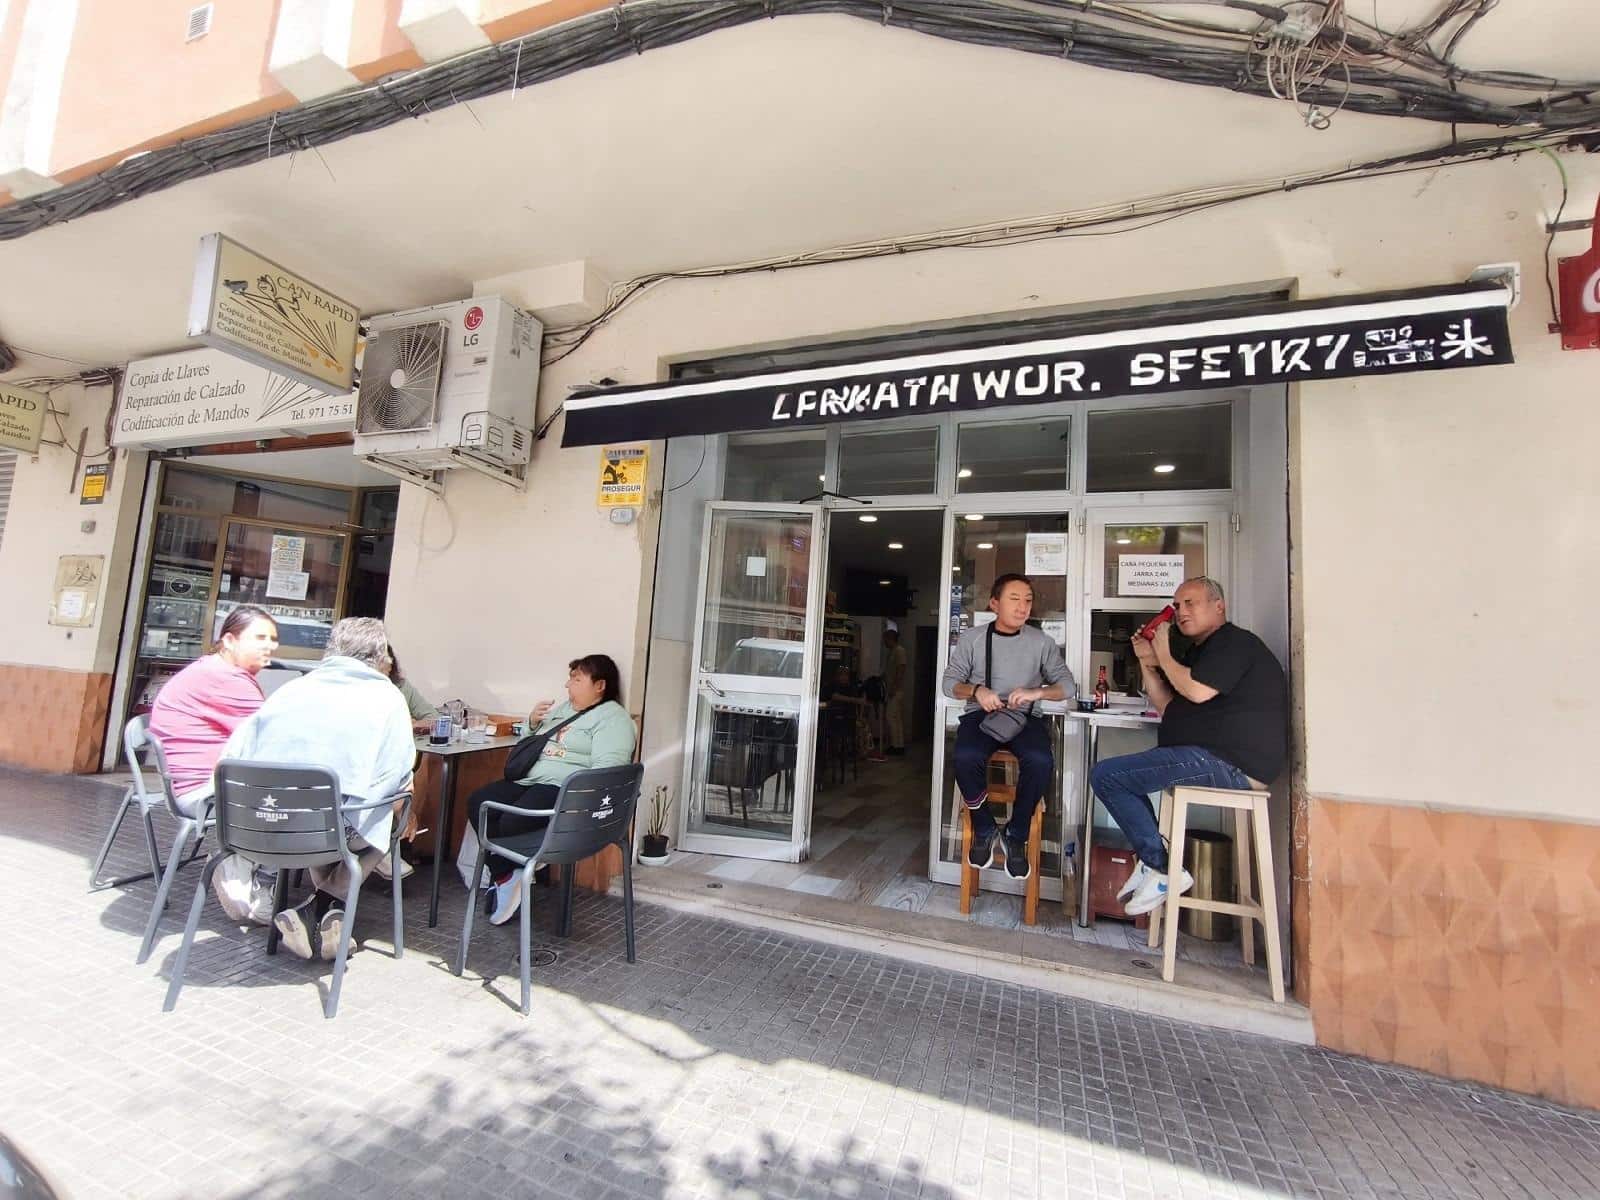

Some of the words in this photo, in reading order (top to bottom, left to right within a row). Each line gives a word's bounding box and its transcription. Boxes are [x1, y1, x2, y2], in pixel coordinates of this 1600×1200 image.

[219, 302, 245, 319] Copia
[246, 315, 257, 326] de
[258, 319, 283, 336] Llaves
[314, 294, 354, 324] RAPID
[216, 321, 270, 350] Codificación
[271, 344, 281, 355] de
[282, 348, 312, 368] Mandos
[218, 311, 264, 339] Reparación
[265, 332, 276, 342] de
[277, 338, 308, 357] Calzado
[463, 333, 479, 347] LG
[129, 371, 159, 388] Copia
[161, 367, 175, 382] de
[176, 364, 210, 380] Llaves
[125, 388, 181, 411] Reparación
[183, 386, 197, 402] de
[199, 379, 246, 399] Calzado
[121, 414, 185, 433] Codificación
[187, 408, 201, 424] de
[203, 403, 250, 423] Mandos
[291, 408, 306, 421] Tel.
[308, 407, 325, 419] 971
[328, 405, 340, 416] 75
[342, 403, 353, 415] 51
[601, 484, 641, 493] PROSEGUR
